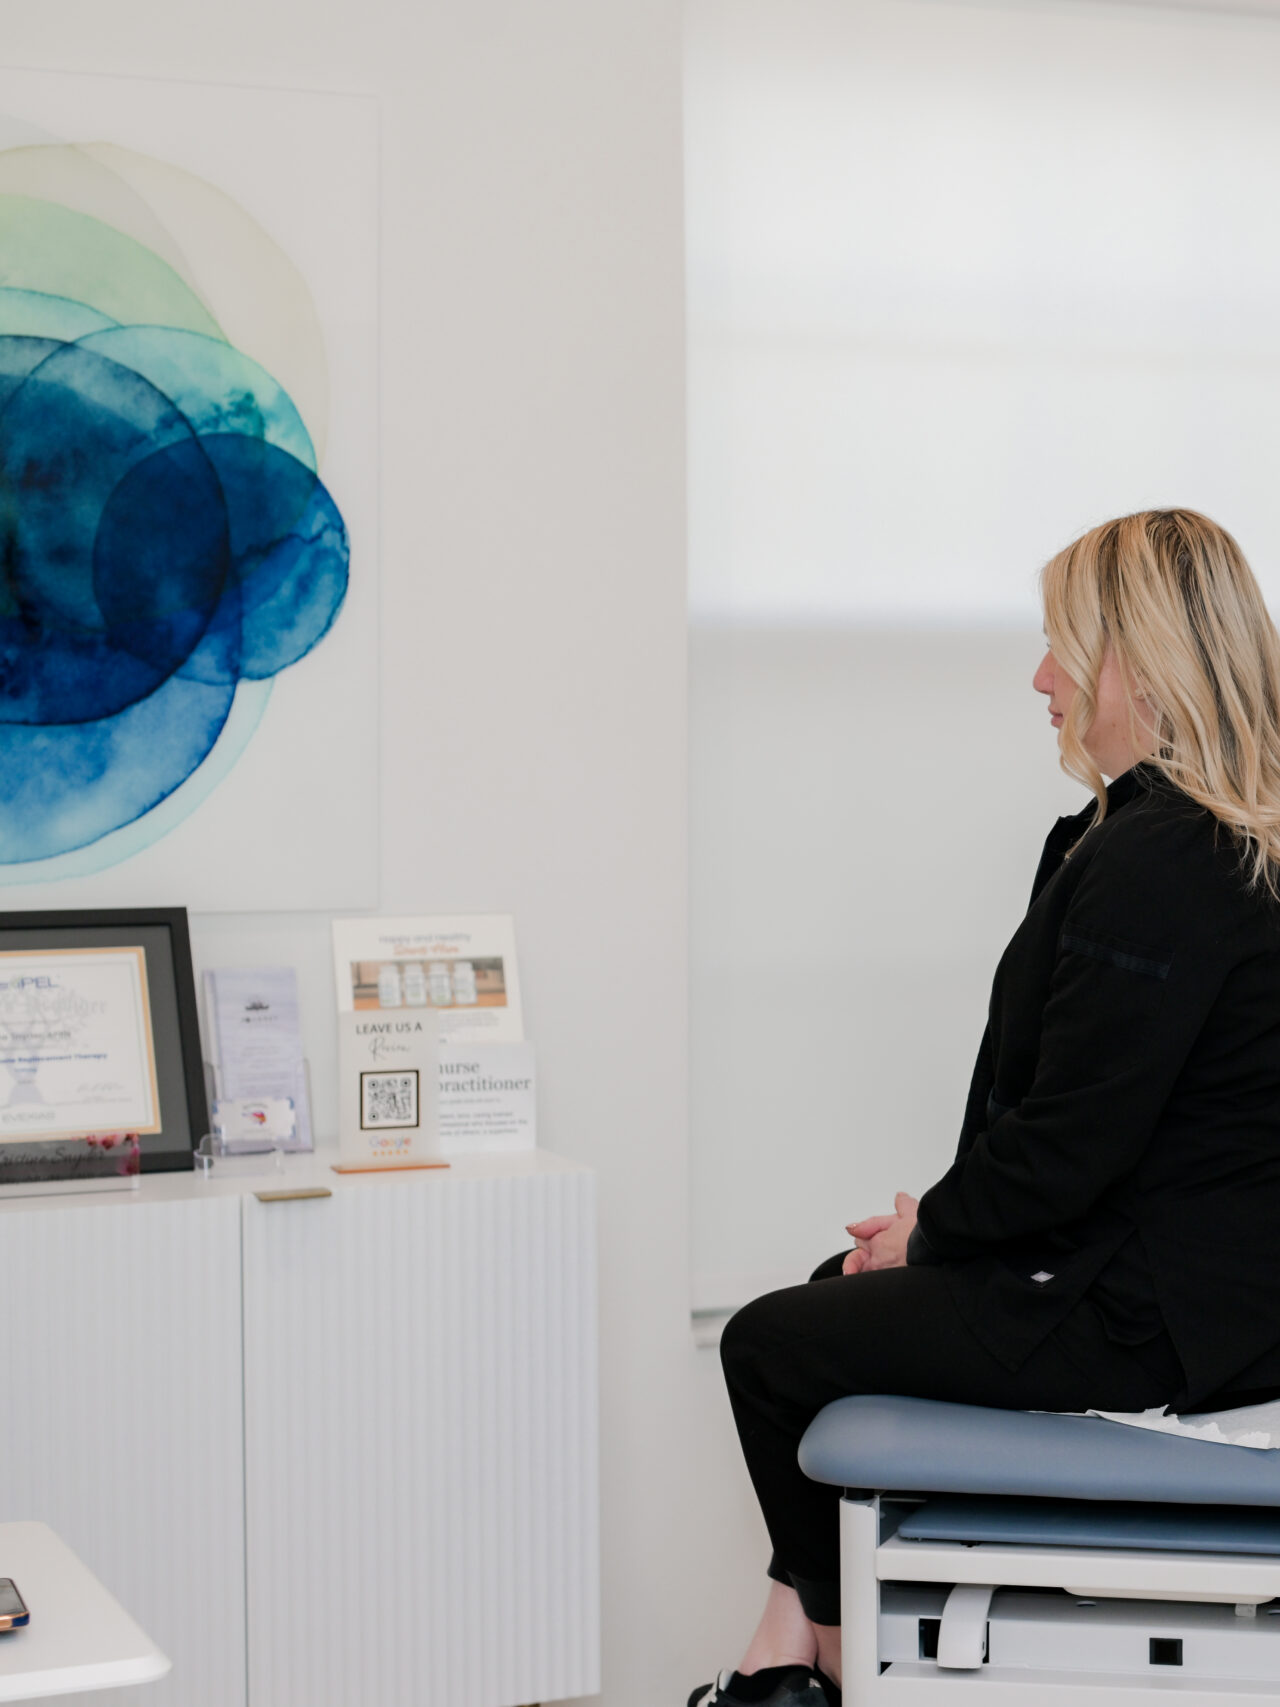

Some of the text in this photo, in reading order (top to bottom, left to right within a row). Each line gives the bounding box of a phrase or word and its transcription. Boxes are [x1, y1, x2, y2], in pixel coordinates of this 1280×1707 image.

[356, 1021, 423, 1034] LEAVE US A
[368, 1136, 412, 1149] Google
